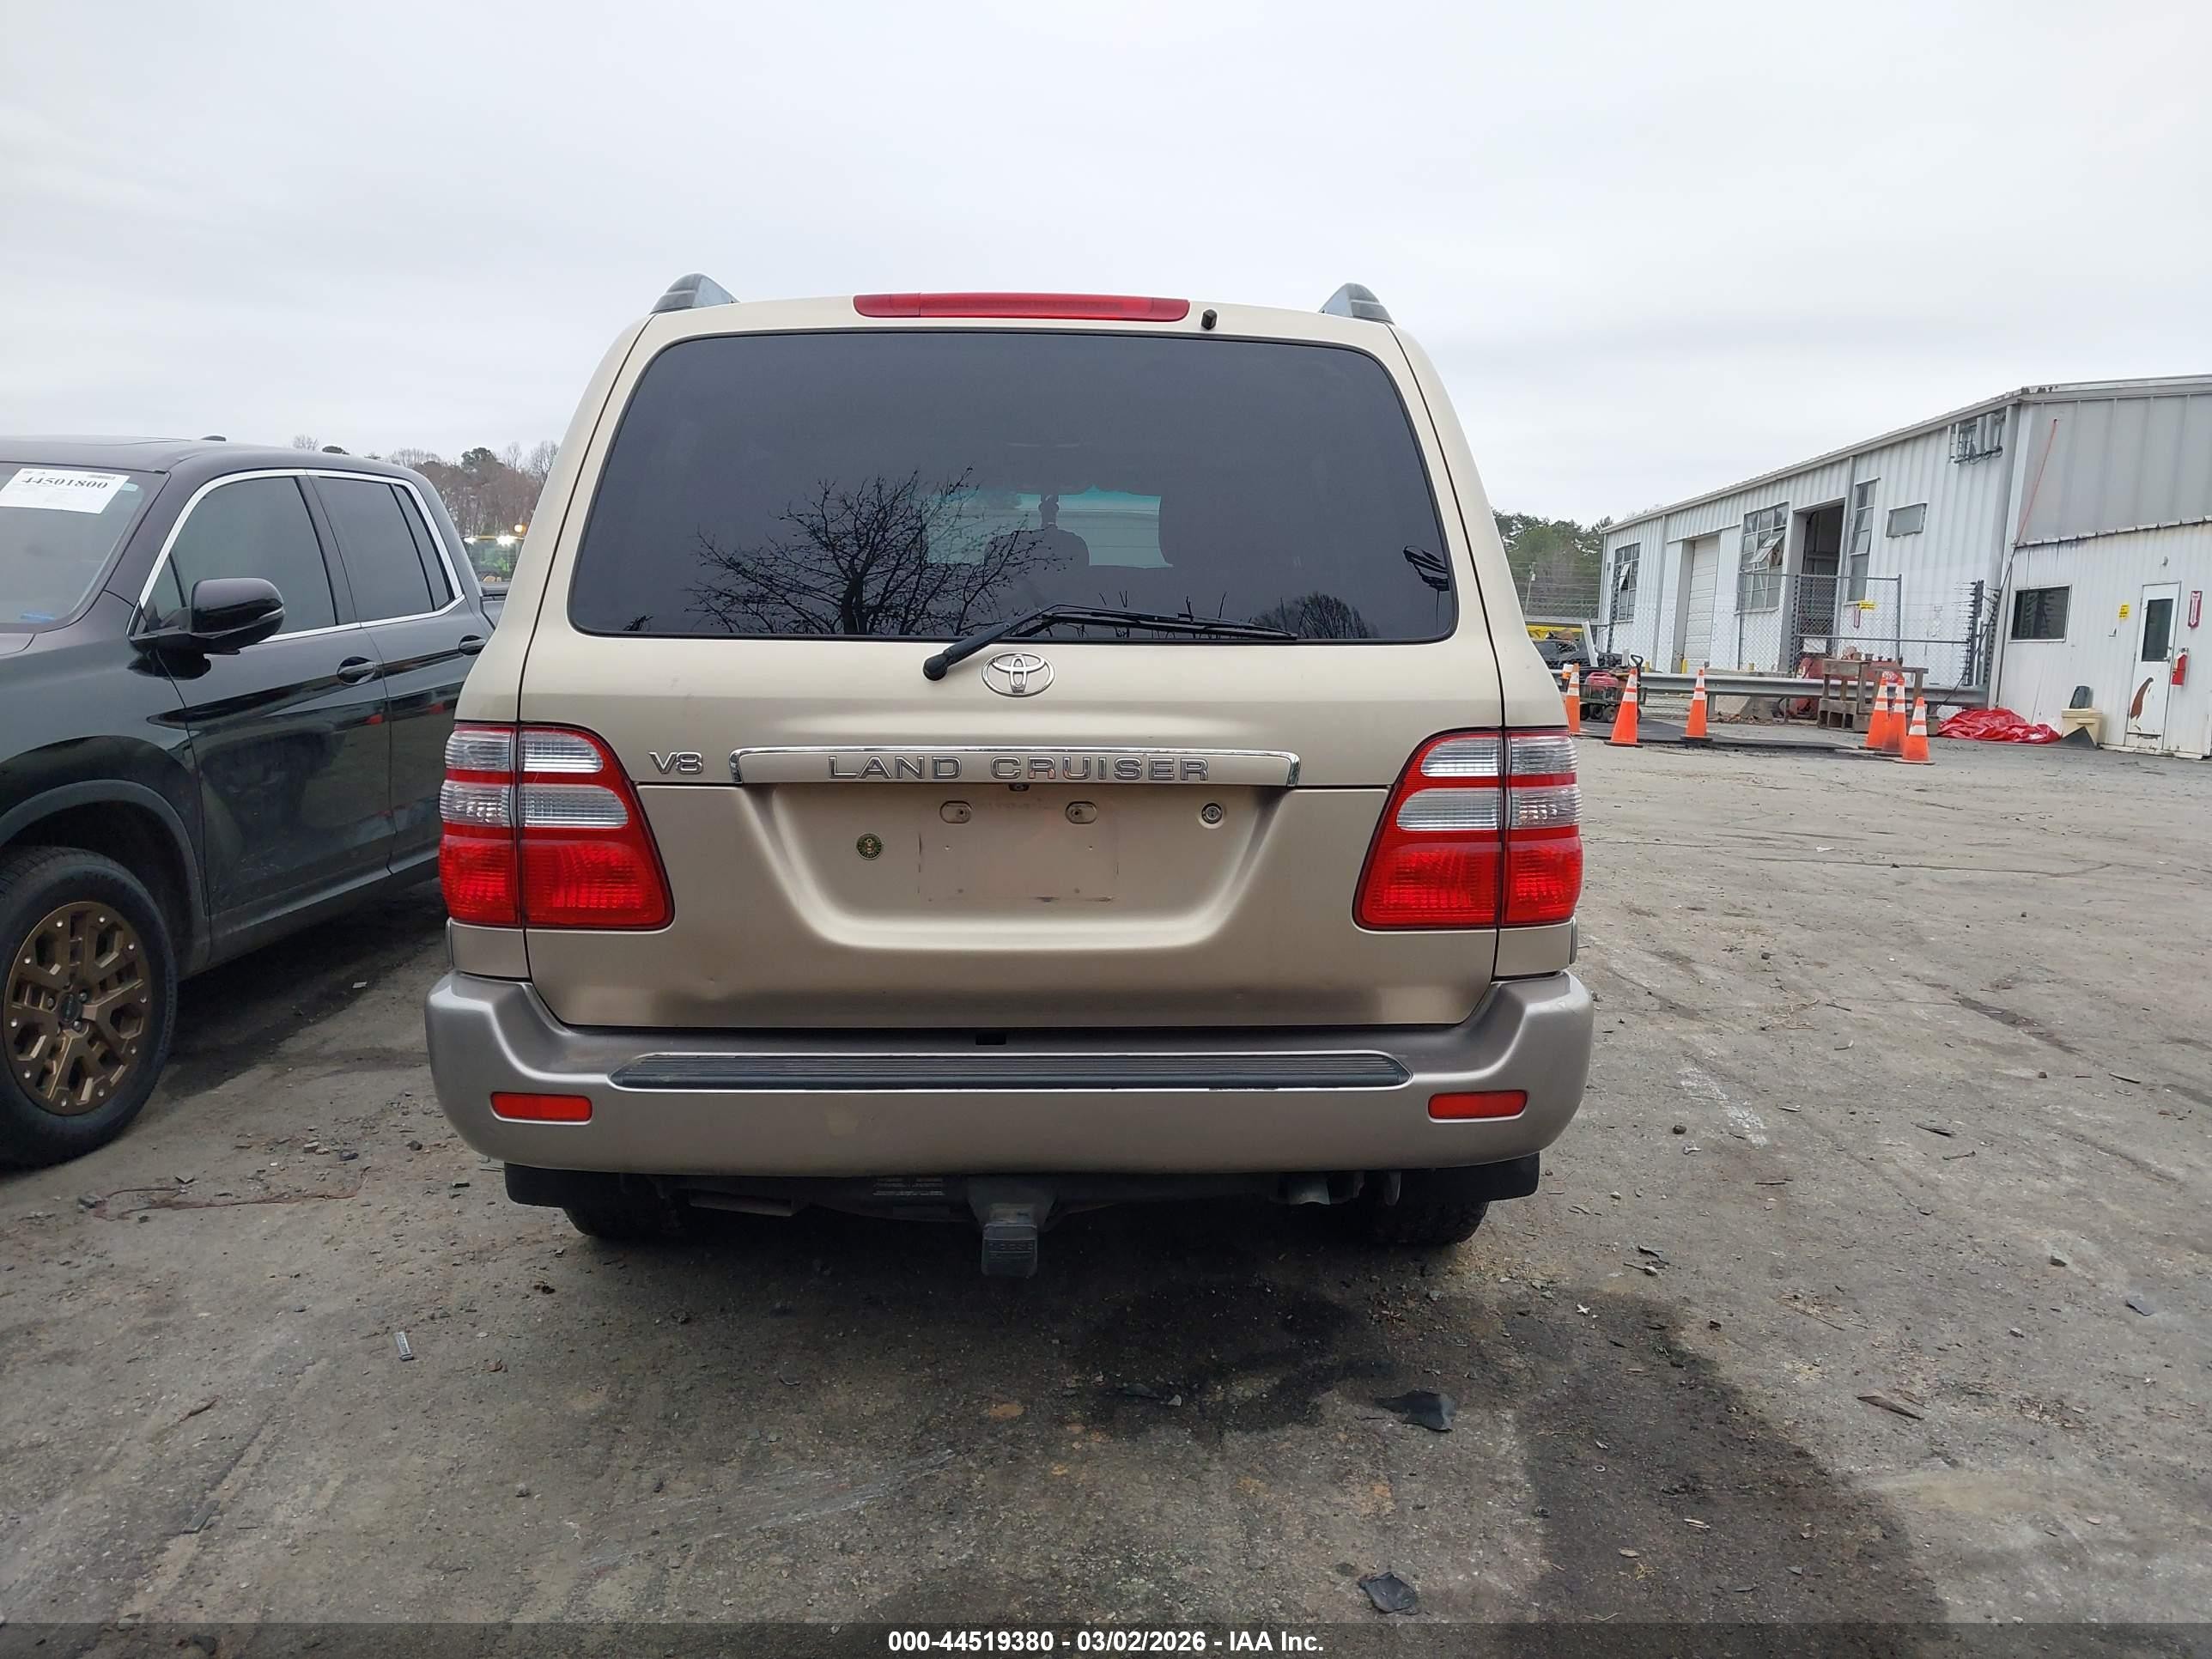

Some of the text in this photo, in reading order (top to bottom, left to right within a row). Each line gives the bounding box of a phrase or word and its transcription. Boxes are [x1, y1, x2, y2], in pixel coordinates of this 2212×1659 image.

[21, 477, 109, 489] 44501800
[648, 751, 704, 775] V8
[828, 756, 1209, 781] LAND CRUISER
